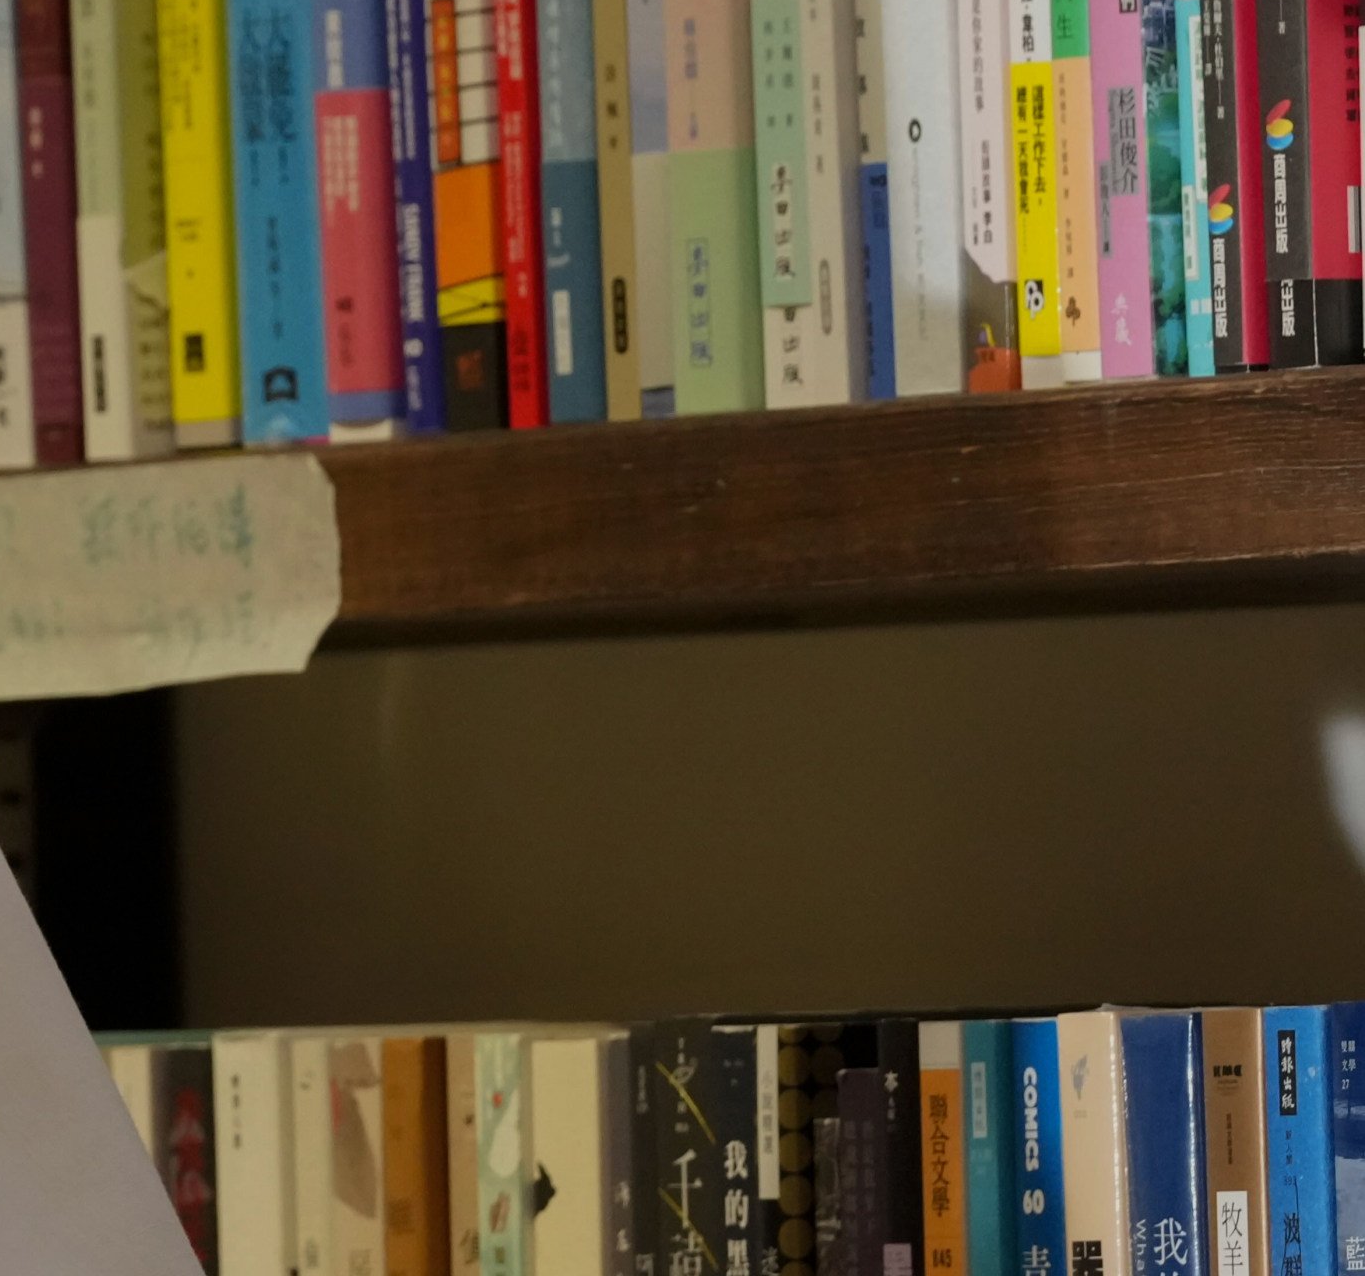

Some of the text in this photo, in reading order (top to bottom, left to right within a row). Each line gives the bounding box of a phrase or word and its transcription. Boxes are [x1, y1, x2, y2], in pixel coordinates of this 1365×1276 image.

[1117, 87, 1139, 195] 杉田俊介
[1273, 153, 1289, 254] 商周出版
[1212, 238, 1229, 338] 商周出版
[1022, 1065, 1040, 1173] COMICS
[1279, 1035, 1296, 1111] 時報出版
[928, 1093, 952, 1218] 聯合文學
